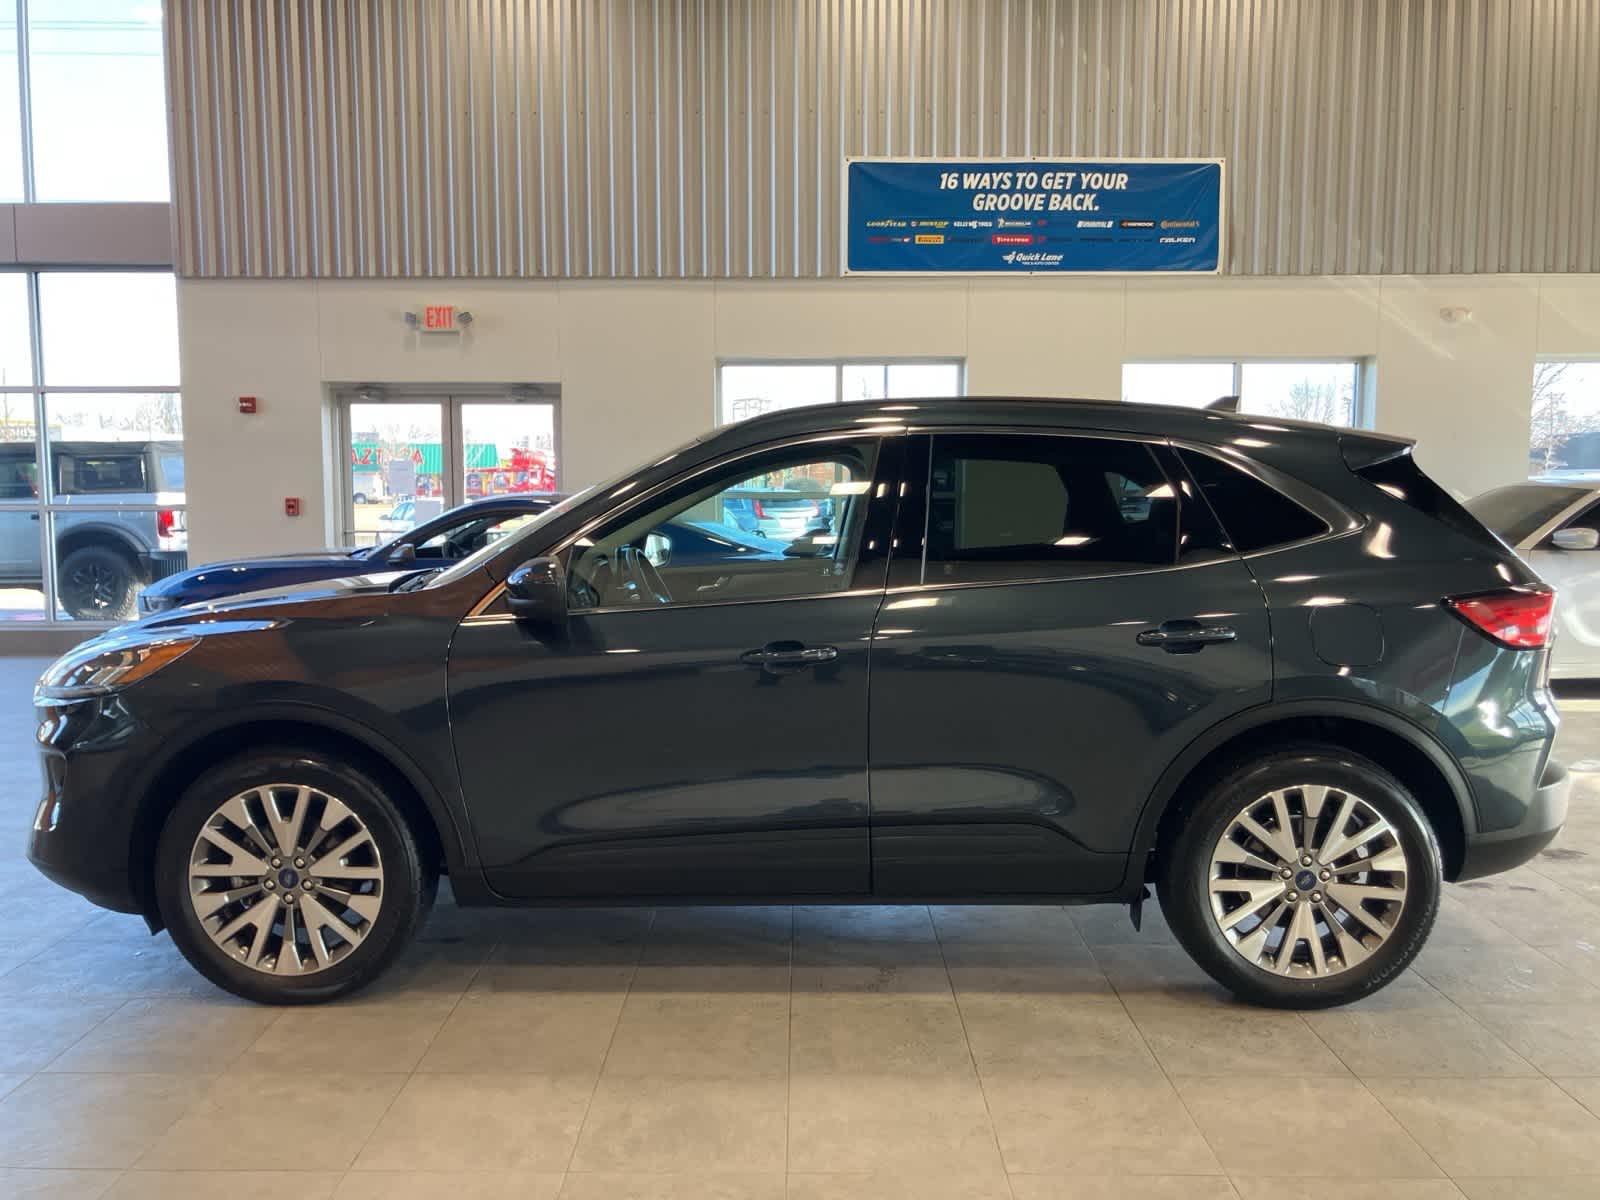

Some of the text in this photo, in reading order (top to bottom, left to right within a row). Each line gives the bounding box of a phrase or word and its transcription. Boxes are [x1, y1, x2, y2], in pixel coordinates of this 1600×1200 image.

[939, 172, 1129, 190] 16 WAYS TO GET YOUR
[973, 193, 1100, 212] GROOVE BACK.
[1016, 252, 1064, 262] Quick Lane
[426, 306, 453, 329] EXIT
